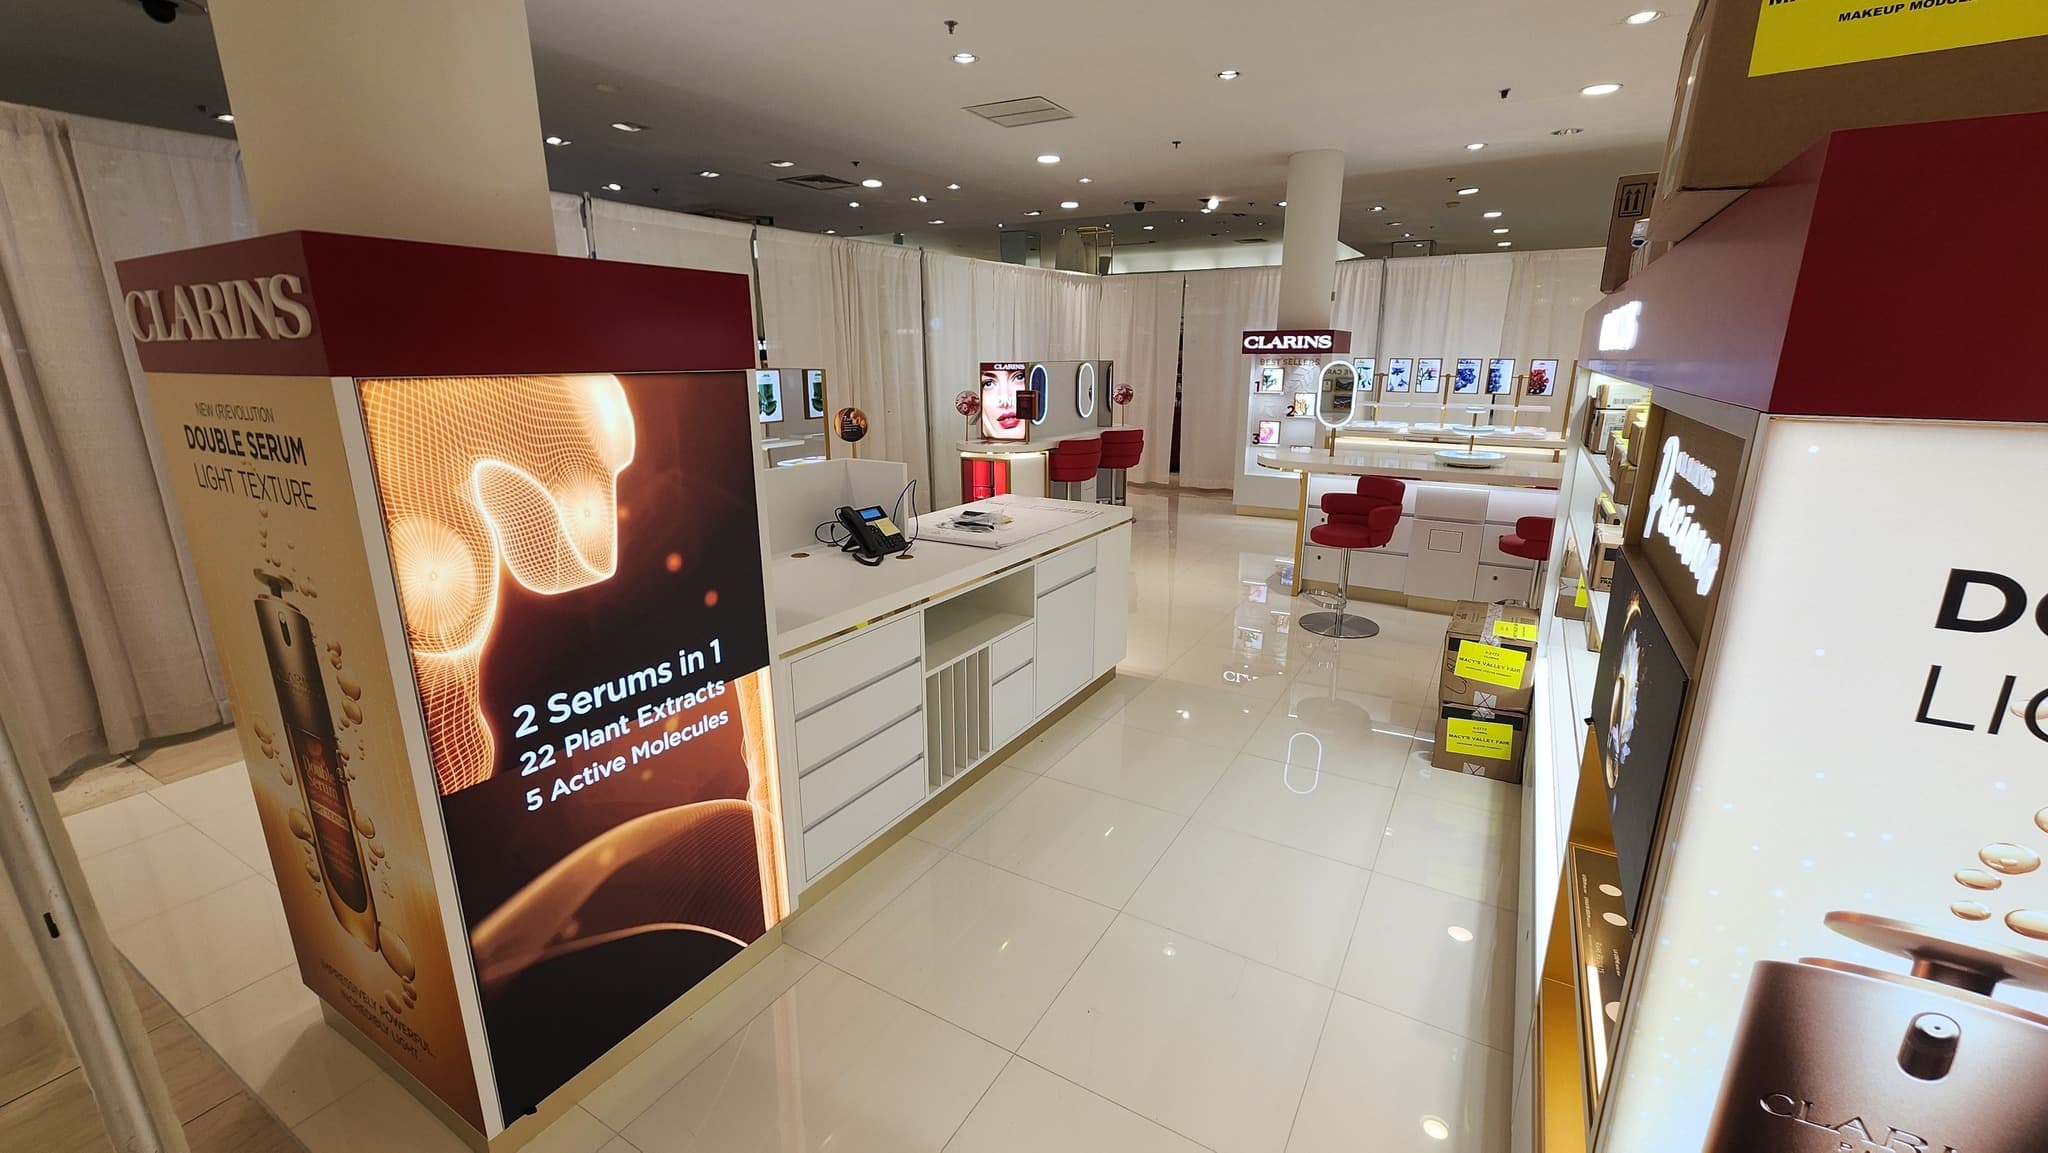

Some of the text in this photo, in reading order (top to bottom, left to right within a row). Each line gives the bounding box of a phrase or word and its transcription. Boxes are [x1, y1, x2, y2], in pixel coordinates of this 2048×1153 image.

[1838, 3, 1904, 22] MAKEUP
[125, 274, 312, 342] CLARINS
[1243, 335, 1332, 349] CLARINS
[1260, 358, 1321, 366] BEST SELLERS
[1254, 381, 1260, 392] 1
[195, 402, 214, 417] NEW
[1286, 405, 1295, 417] 2
[184, 424, 307, 466] DOUBLE SERUM
[1252, 433, 1260, 445] 3
[194, 463, 317, 510] LIGHT TEXTURE
[1459, 657, 1481, 665] MACY'S
[1482, 661, 1505, 669] VALLEY
[512, 638, 721, 738] 2 Serums in 1
[520, 680, 725, 776] 22 Plant Extracts
[526, 710, 729, 811] 5 Active Molecules
